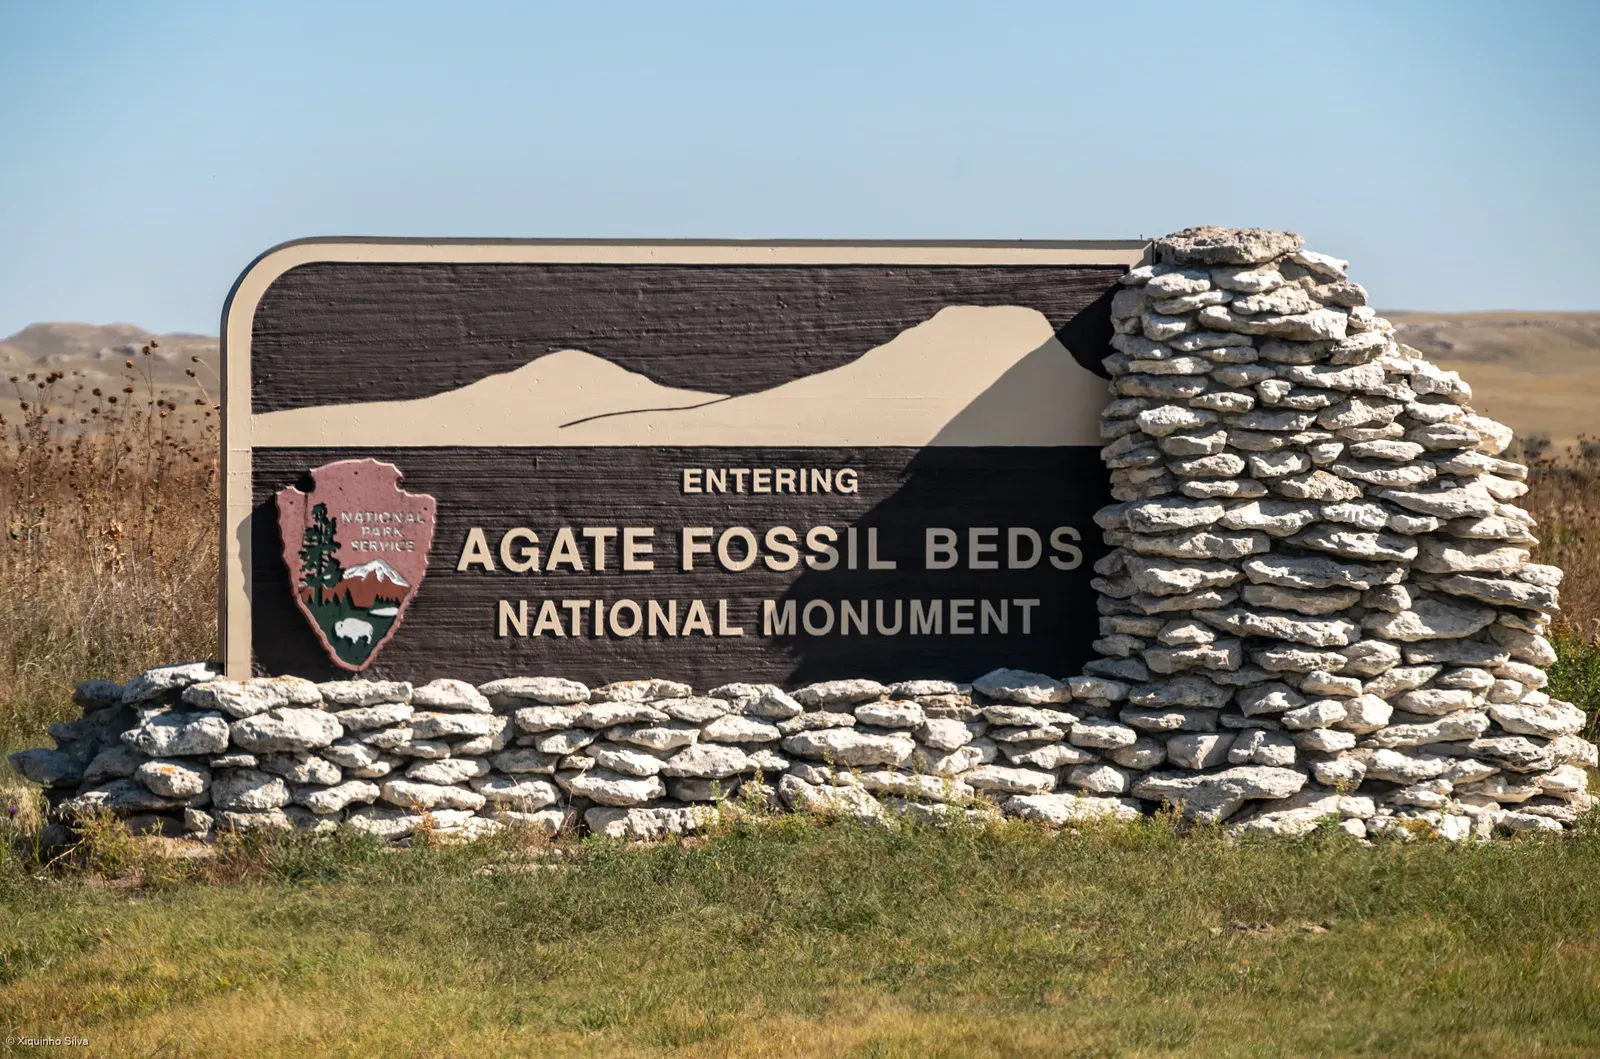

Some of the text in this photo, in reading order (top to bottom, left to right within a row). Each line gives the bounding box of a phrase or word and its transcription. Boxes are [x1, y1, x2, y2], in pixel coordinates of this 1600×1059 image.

[683, 468, 858, 493] ENTERING
[341, 511, 425, 524] NATIONAL
[361, 526, 404, 538] PARK
[350, 540, 415, 552] SERVICE
[457, 526, 1083, 573] AGATE FOSSIL BEDS
[498, 599, 1040, 637] NATIONAL MONUMENT
